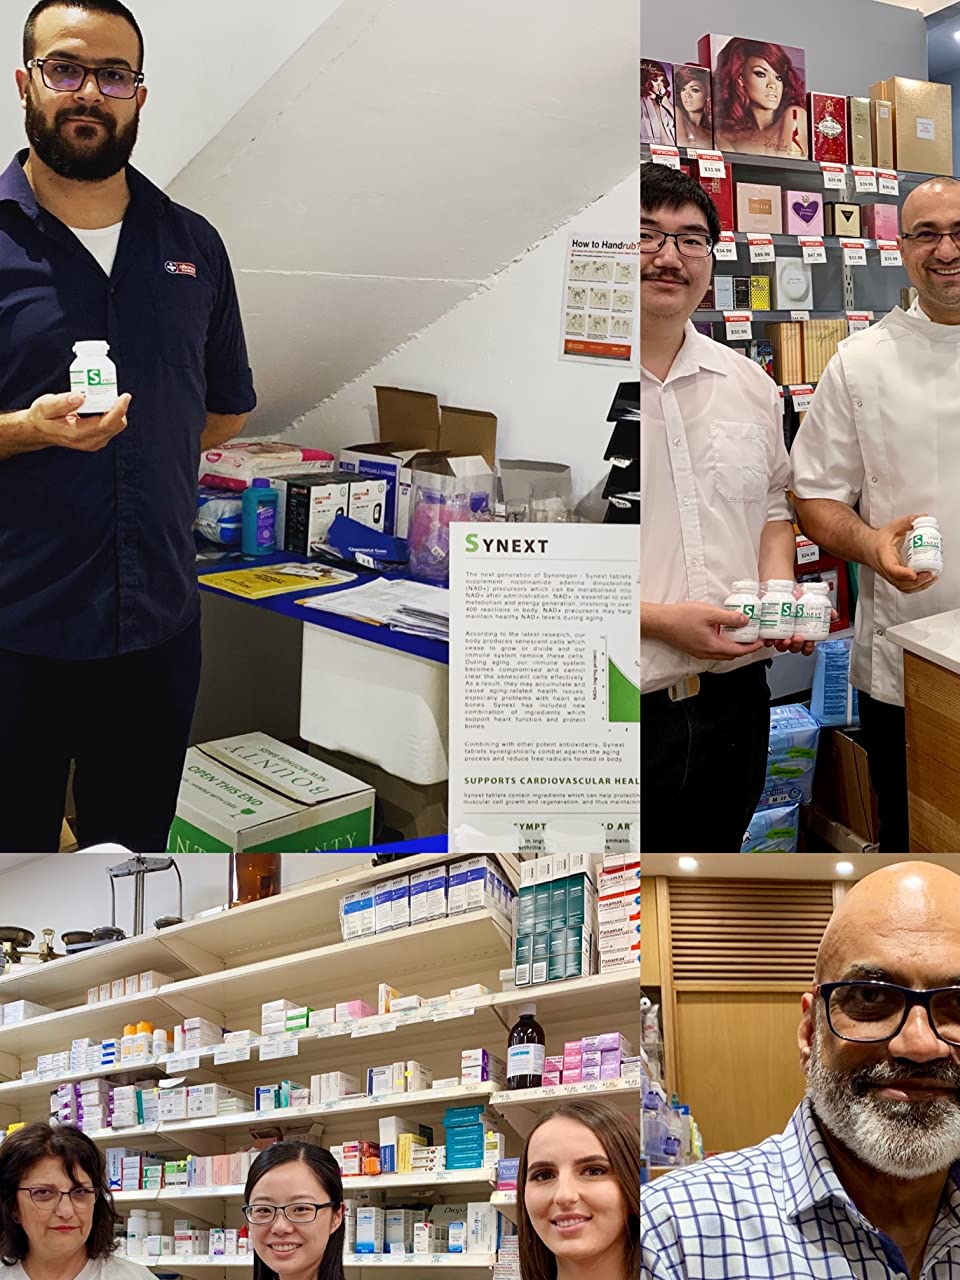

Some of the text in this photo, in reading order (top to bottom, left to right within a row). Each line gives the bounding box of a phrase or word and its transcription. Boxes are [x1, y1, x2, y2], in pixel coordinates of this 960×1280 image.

[572, 240, 590, 248] How
[465, 533, 549, 553] SYNEXT
[187, 765, 264, 807] OPEN THIS END
[464, 777, 516, 785] SUPPORTS
[520, 777, 611, 785] CARDIOVASCULAR
